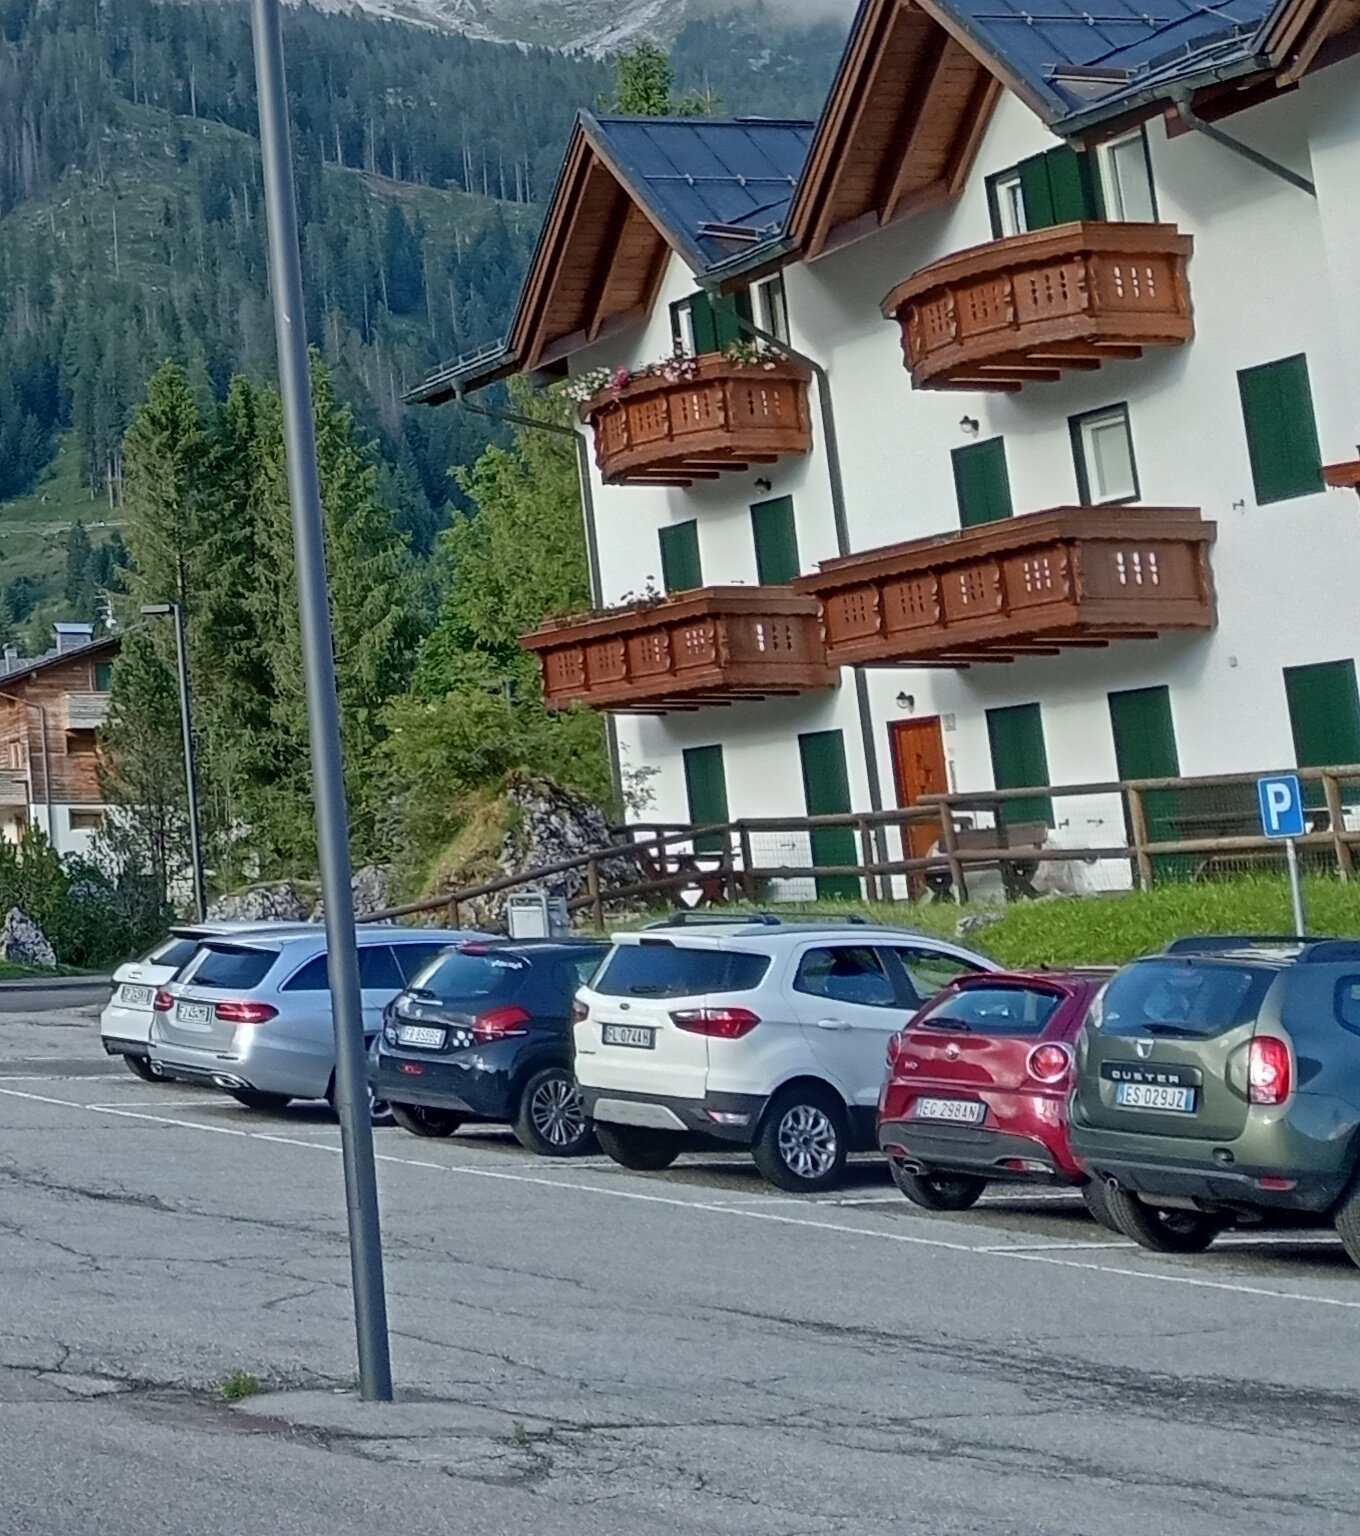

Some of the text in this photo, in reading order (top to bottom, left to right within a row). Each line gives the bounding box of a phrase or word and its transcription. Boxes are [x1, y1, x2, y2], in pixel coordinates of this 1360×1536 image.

[1266, 783, 1292, 831] P
[1111, 1069, 1180, 1084] DUSTER
[1124, 1085, 1185, 1109] ES 029JZ
[921, 1100, 977, 1120] EG 298AN
